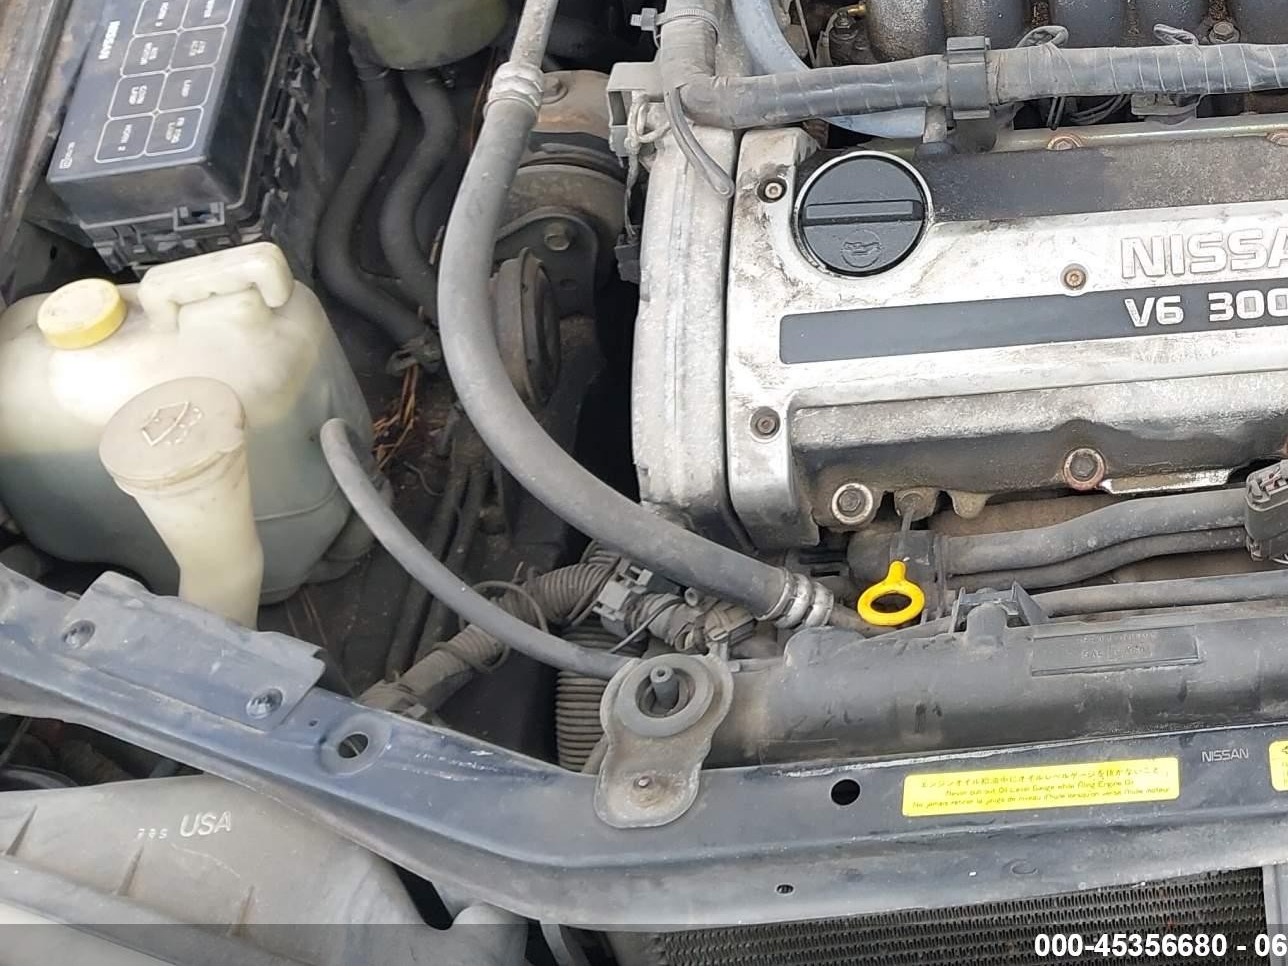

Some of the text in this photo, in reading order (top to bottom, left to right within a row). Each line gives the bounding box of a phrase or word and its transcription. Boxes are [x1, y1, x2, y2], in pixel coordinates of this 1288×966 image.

[99, 21, 120, 60] NISSAN
[1124, 295, 1186, 328] V6
[1201, 747, 1250, 763] NISSAN
[180, 811, 232, 838] USA
